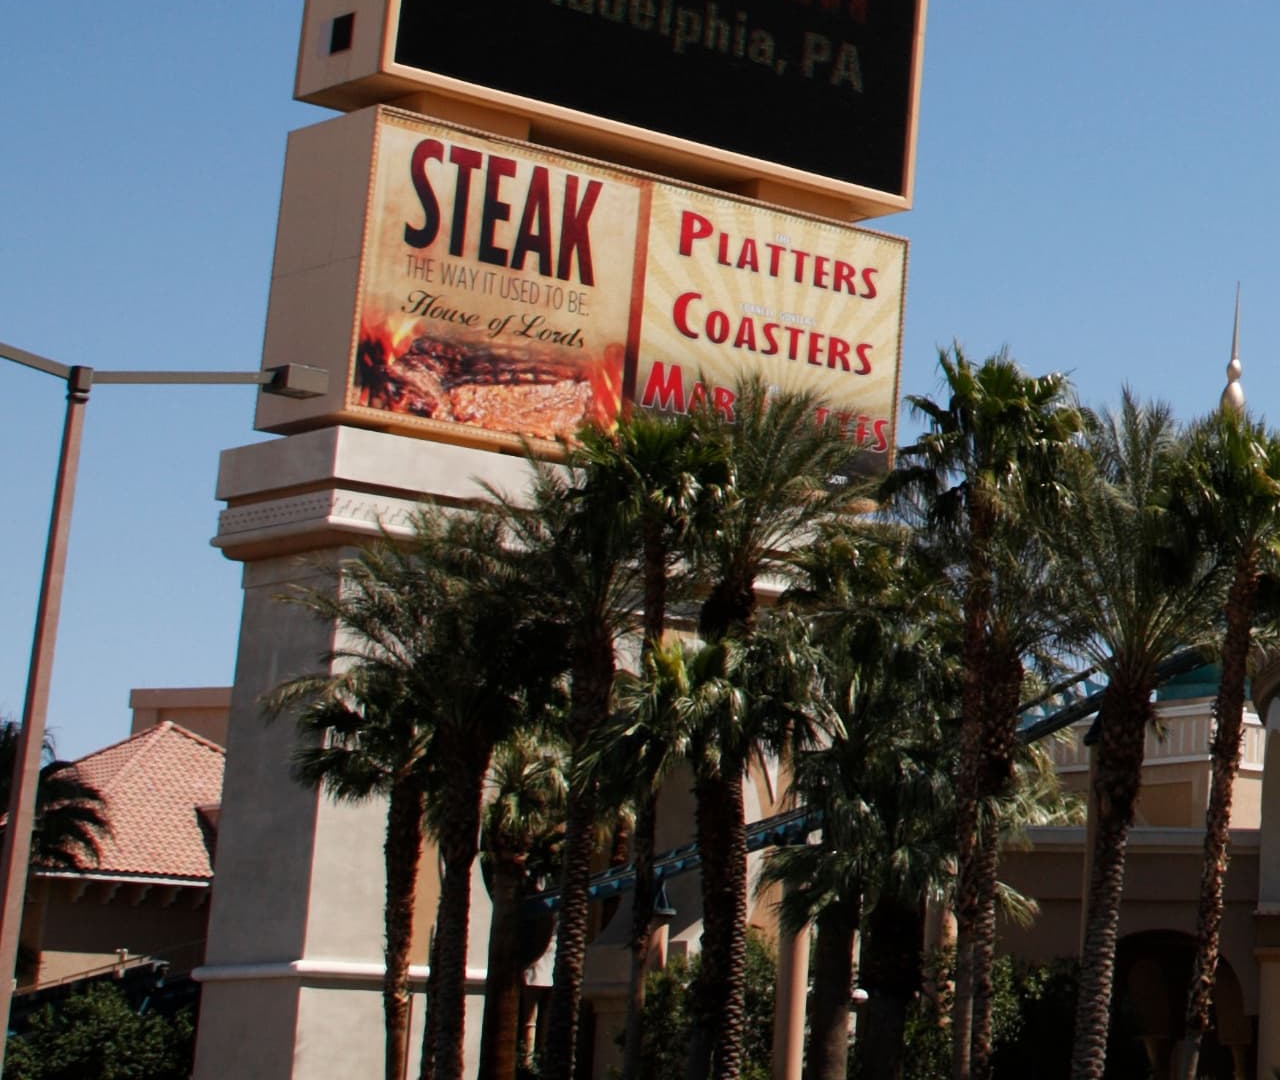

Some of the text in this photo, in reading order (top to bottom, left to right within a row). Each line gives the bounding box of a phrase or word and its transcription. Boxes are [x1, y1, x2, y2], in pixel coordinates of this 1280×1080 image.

[801, 30, 865, 94] PA
[404, 138, 603, 287] STEAK
[407, 254, 590, 317] THE WAY IT USED TO BE.
[679, 210, 879, 300] PLATTERS
[401, 289, 585, 349] House of Lords
[673, 292, 873, 376] COASTERS
